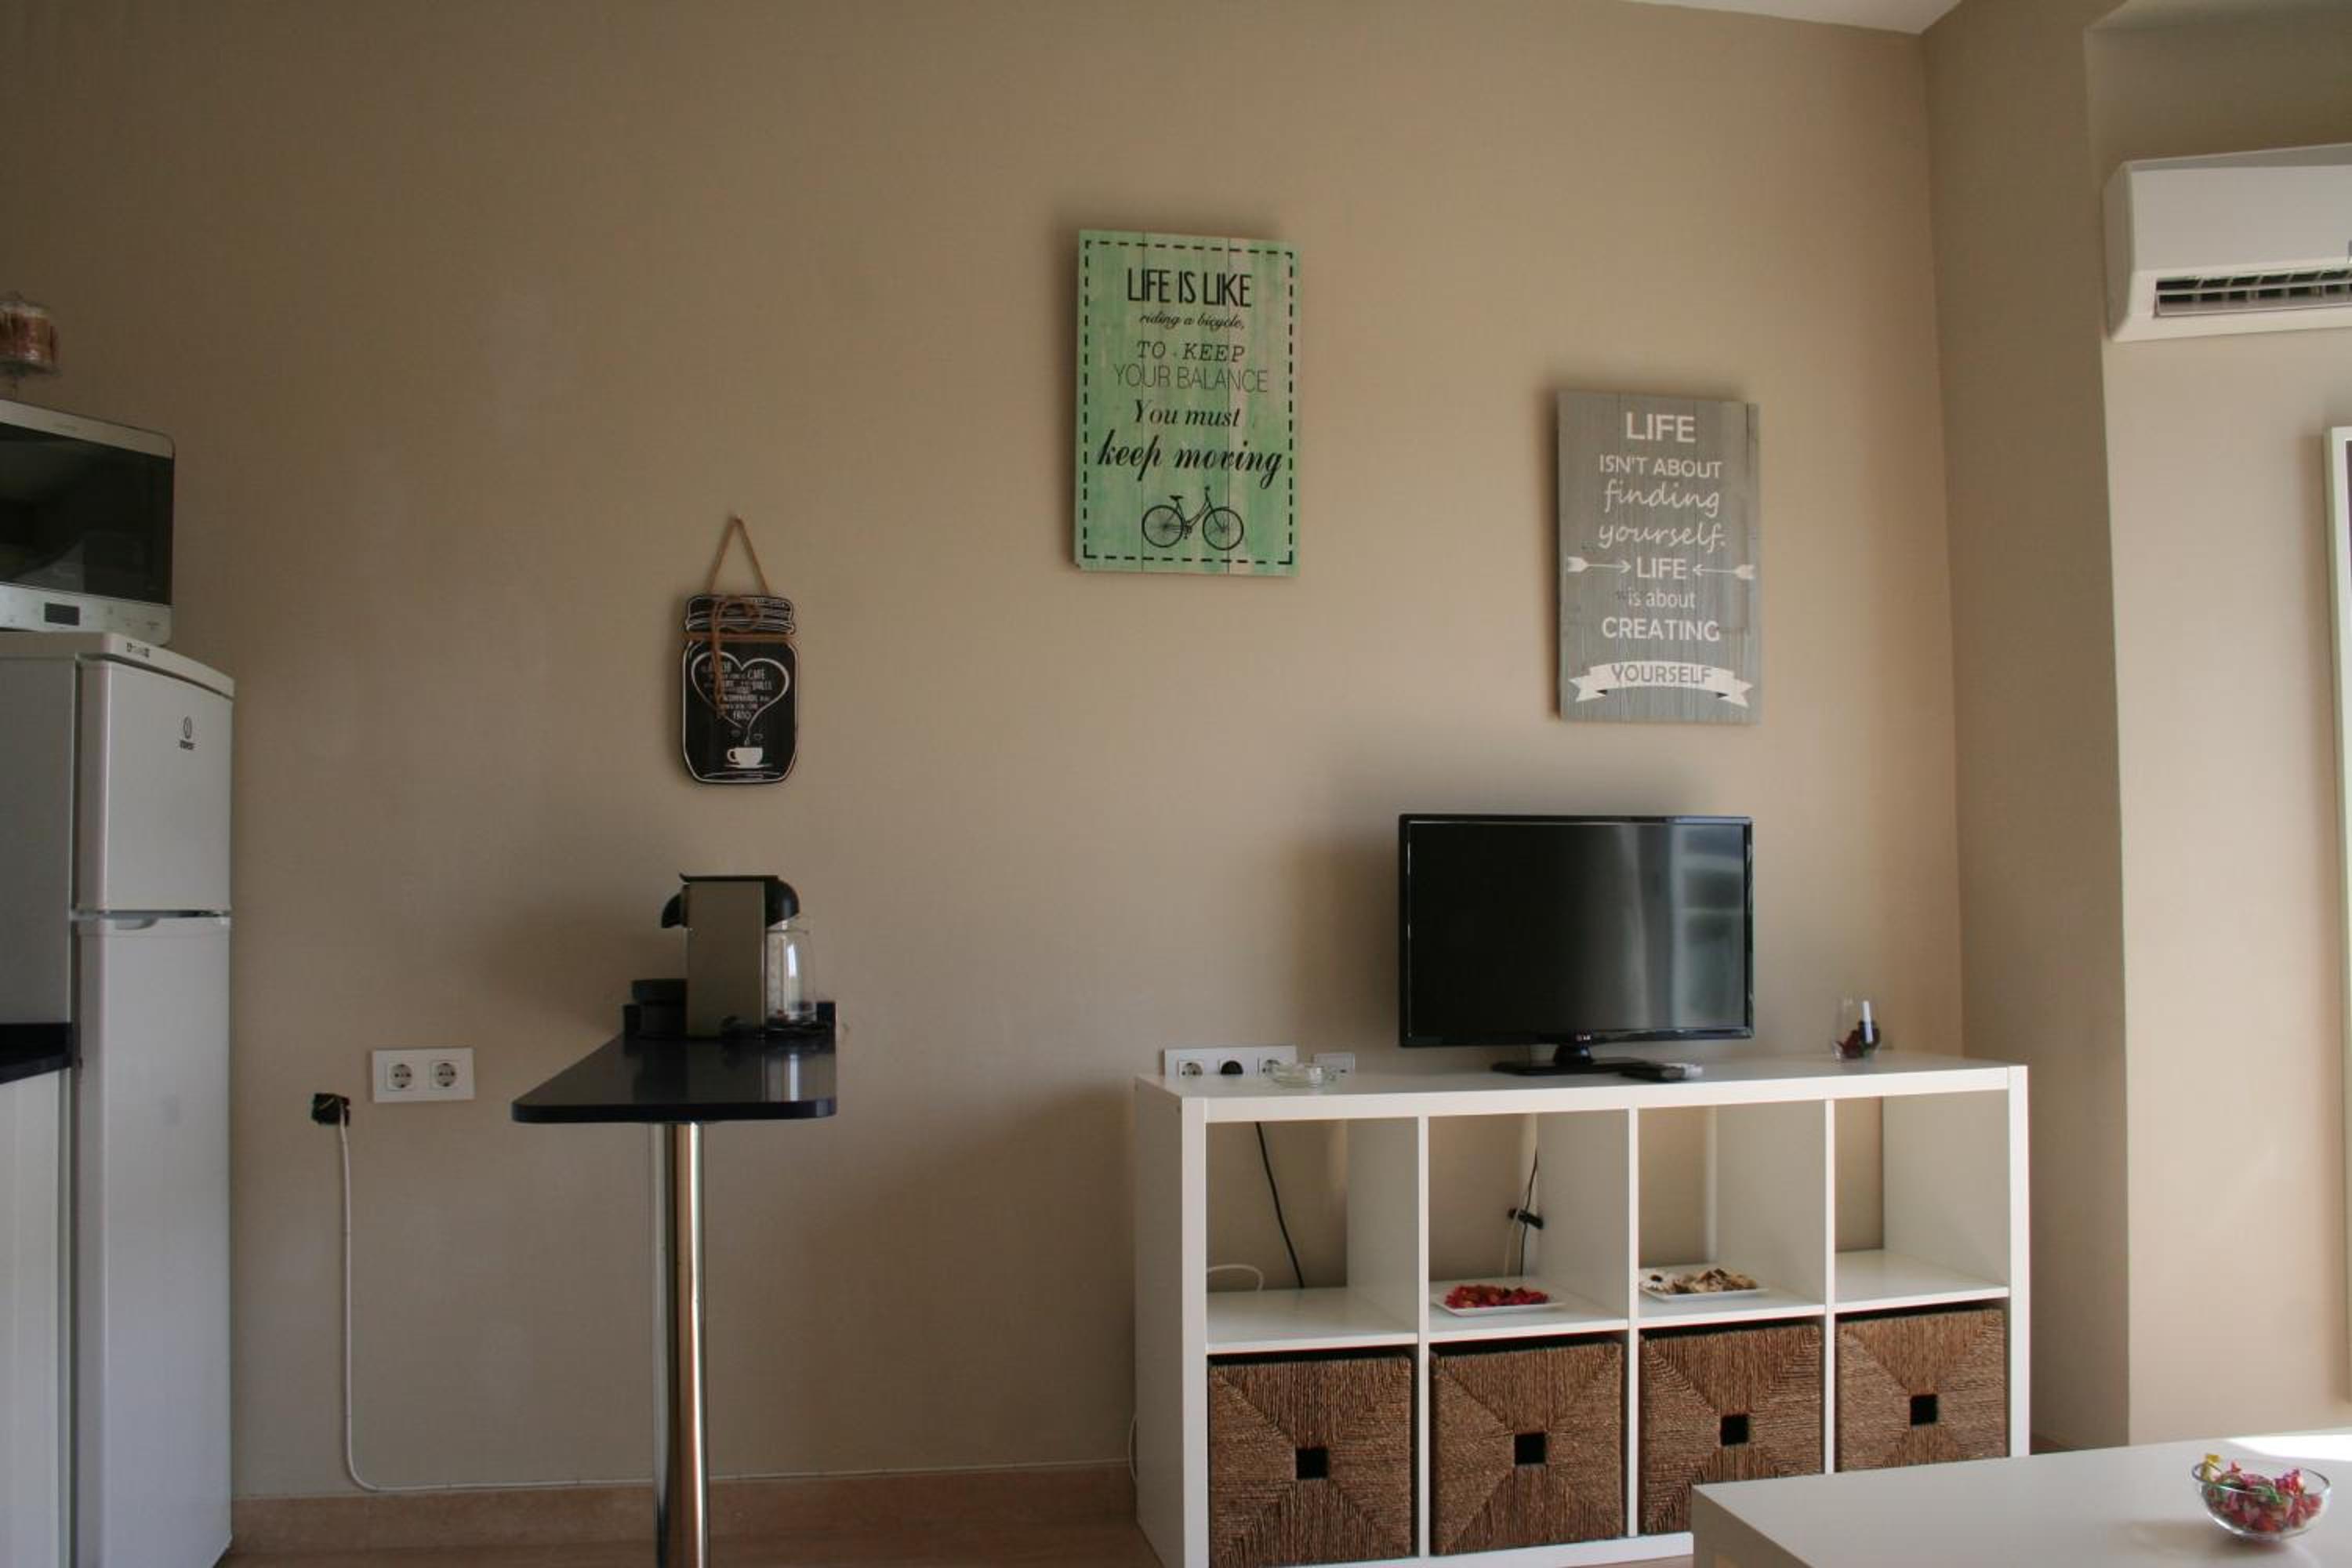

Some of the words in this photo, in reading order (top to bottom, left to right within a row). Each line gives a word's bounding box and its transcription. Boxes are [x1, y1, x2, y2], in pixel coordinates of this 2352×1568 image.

[1127, 267, 1171, 303] LIFE
[1178, 270, 1197, 304] IS
[1203, 271, 1252, 307] LIKE
[1139, 310, 1180, 330] riding
[1183, 316, 1192, 325] a
[1137, 340, 1167, 359] TO
[1181, 343, 1245, 363] KEEP
[1113, 363, 1171, 389] YOUR
[1177, 365, 1269, 393] BALANCE
[1134, 399, 1178, 425] You
[1185, 408, 1241, 427] must
[1626, 411, 1696, 444] LIFE
[1098, 429, 1162, 481] keep
[1174, 440, 1283, 489] moving
[1599, 454, 1648, 474] ISN'T
[1653, 458, 1723, 479] ABOUT
[1604, 478, 1720, 518] finding
[1636, 556, 1687, 580] LIFE
[1628, 587, 1642, 607] is
[1646, 590, 1697, 610] about
[1602, 616, 1721, 642] CREATING
[1611, 664, 1712, 685] YOURSELF
